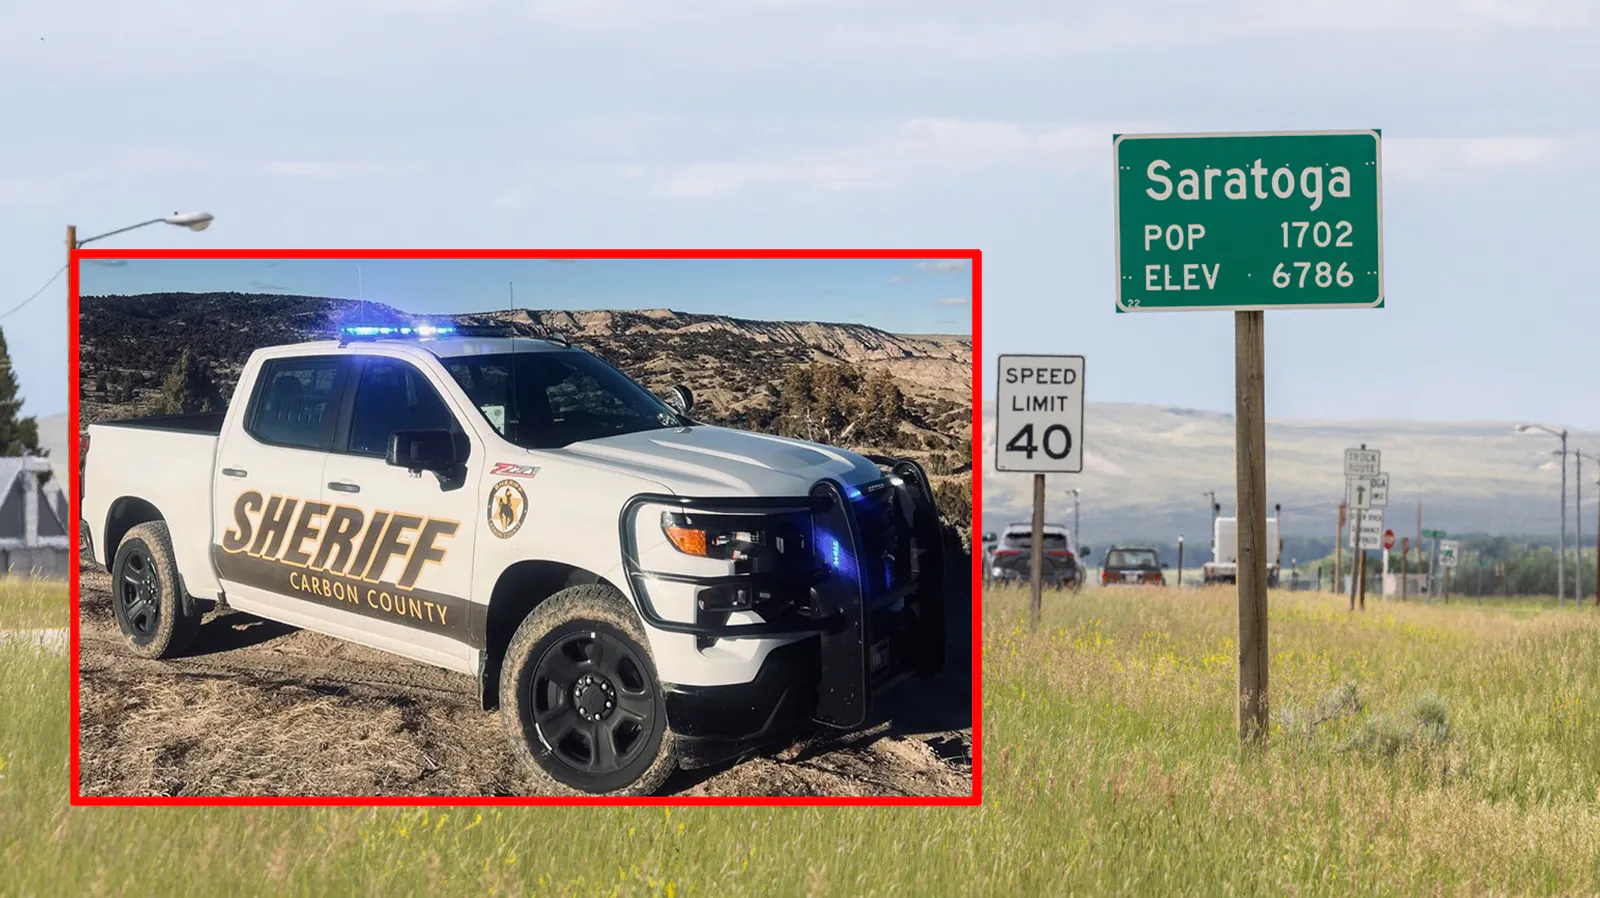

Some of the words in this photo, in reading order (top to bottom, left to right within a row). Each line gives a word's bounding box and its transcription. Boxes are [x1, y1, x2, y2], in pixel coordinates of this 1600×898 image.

[1145, 158, 1351, 212] Saratoga
[1144, 223, 1206, 251] POP
[1281, 220, 1354, 248] 1702
[1145, 263, 1221, 291] ELEV
[1272, 261, 1354, 289] 6786
[1005, 367, 1077, 385] SPEED
[1012, 395, 1069, 412] LIMIT
[1005, 423, 1073, 460] 40
[1348, 463, 1376, 473] ROUTE
[221, 489, 462, 591] SHERIFF
[289, 571, 359, 606] CARBON
[366, 589, 449, 626] COUNTY
